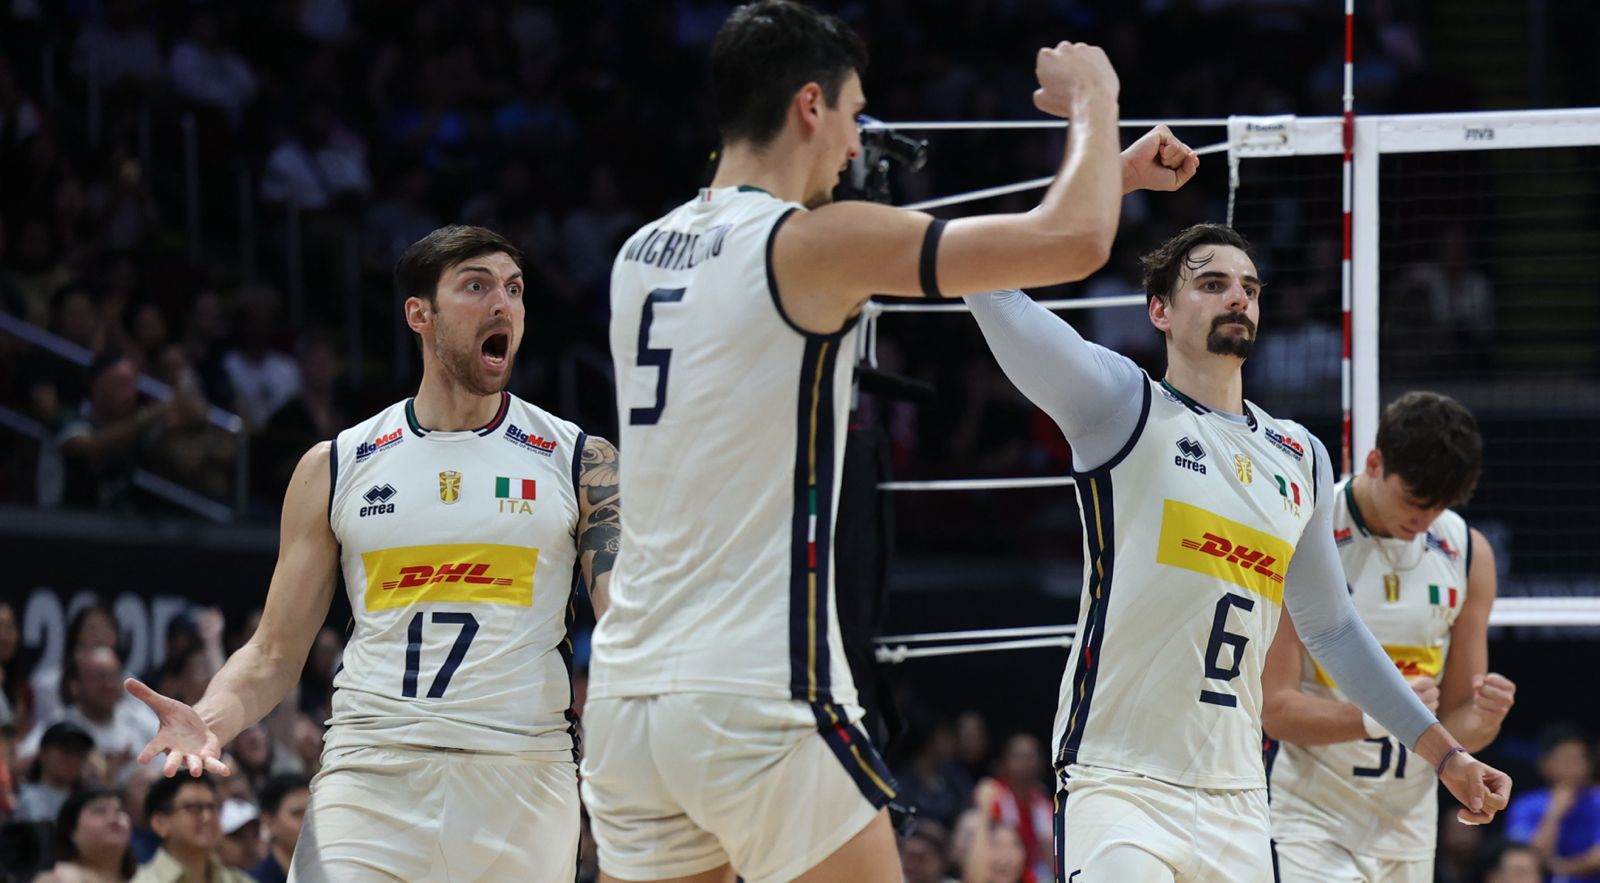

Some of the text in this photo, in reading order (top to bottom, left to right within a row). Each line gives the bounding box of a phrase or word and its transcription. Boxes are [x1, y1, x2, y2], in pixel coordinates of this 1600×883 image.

[629, 287, 686, 425] 5
[506, 423, 557, 450] BigMat
[1174, 454, 1207, 475] errea
[359, 503, 395, 517] errea
[499, 500, 533, 515] ITA
[1198, 532, 1279, 580] DHL
[398, 563, 500, 588] DHL
[1204, 592, 1255, 681] 6
[402, 612, 480, 698] 17
